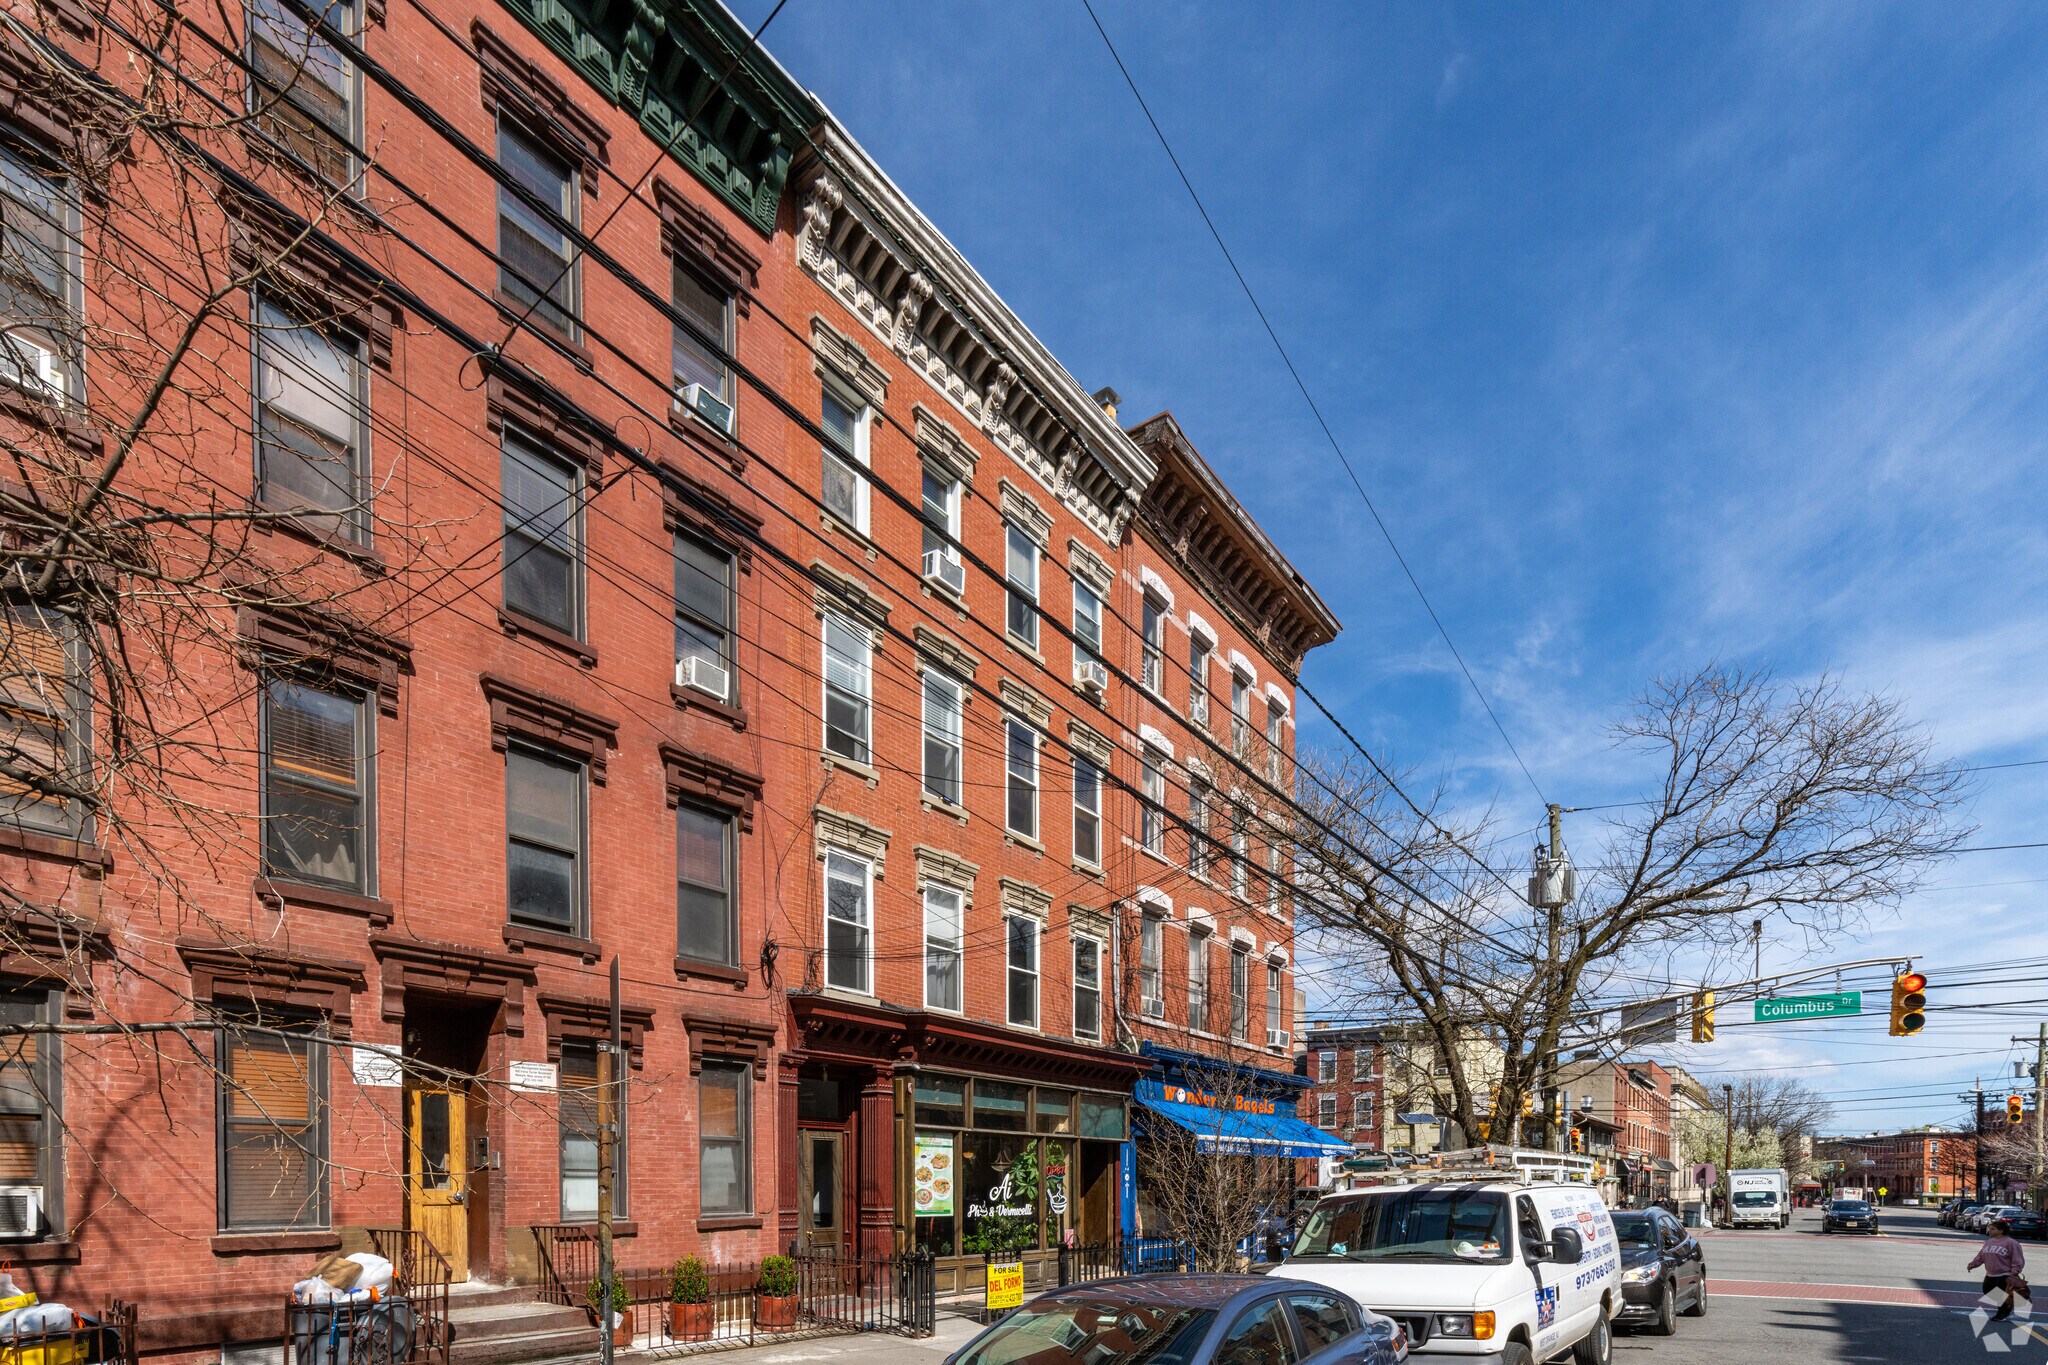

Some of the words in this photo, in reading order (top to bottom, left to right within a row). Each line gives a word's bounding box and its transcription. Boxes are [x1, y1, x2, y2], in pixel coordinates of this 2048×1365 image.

[1762, 1001, 1835, 1016] Columbus
[1842, 997, 1853, 1005] Dr
[1163, 1085, 1217, 1108] Wonder
[1235, 1095, 1275, 1114] Bagels
[989, 1173, 1013, 1201] Ai
[988, 1206, 995, 1218] &
[996, 1203, 1033, 1216] Vermicelli
[1983, 1245, 2008, 1256] ARIS
[1008, 1265, 1020, 1273] SALE
[989, 1280, 1003, 1292] DEL
